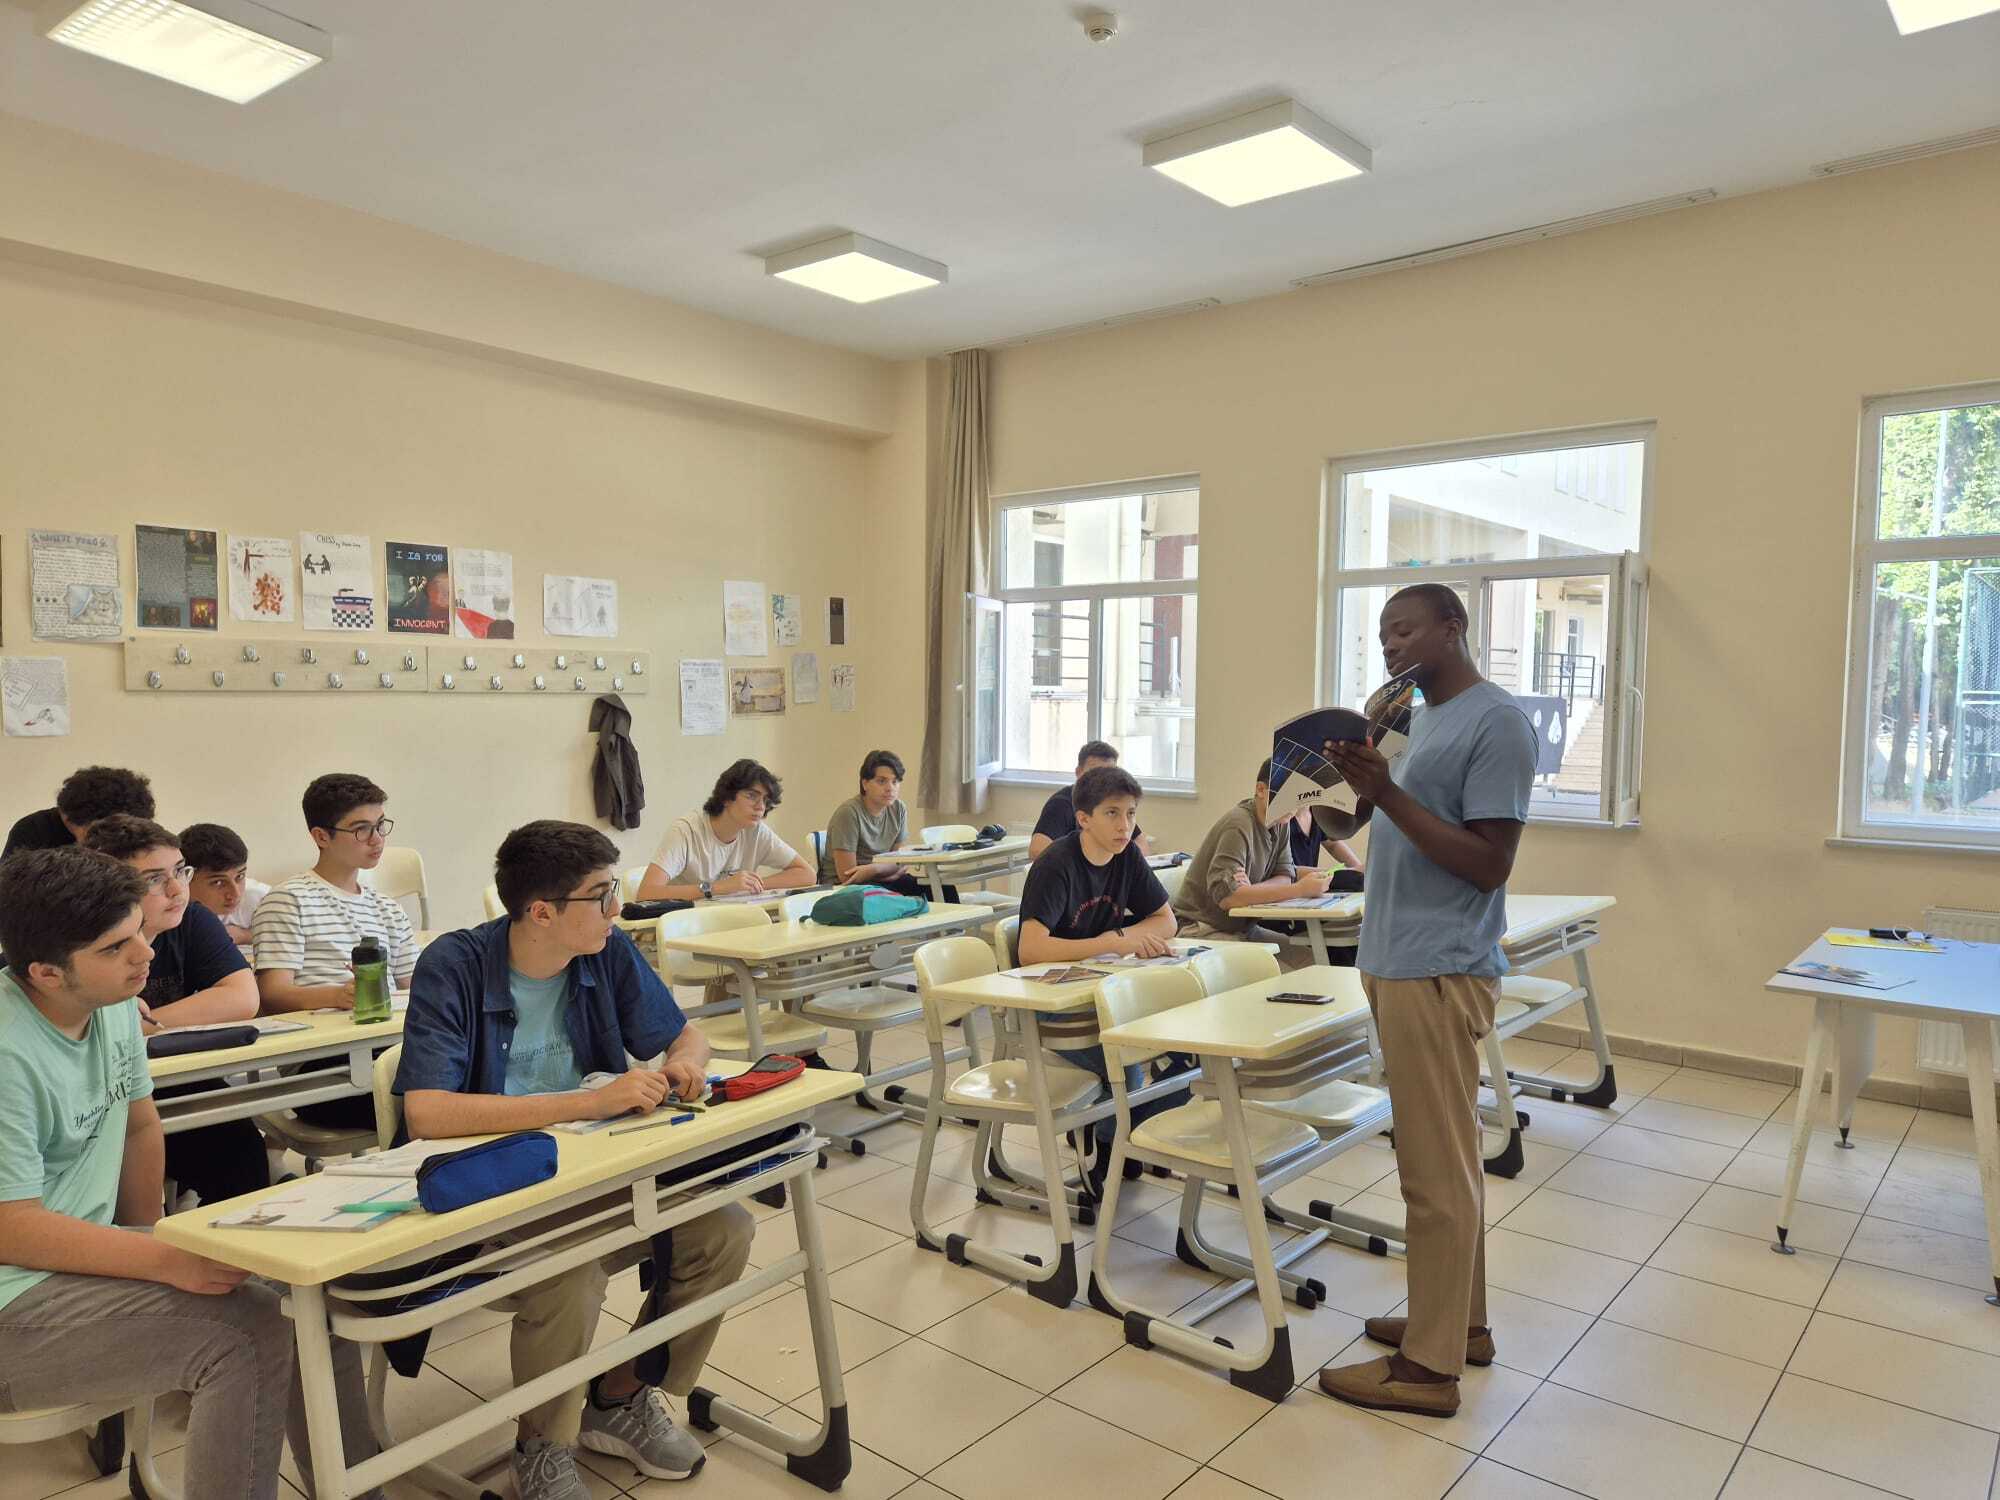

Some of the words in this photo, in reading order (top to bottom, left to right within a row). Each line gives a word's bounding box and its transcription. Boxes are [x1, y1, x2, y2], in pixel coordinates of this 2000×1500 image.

[395, 550, 403, 559] I
[408, 551, 421, 560] IS
[393, 618, 447, 629] INNOCENT
[1297, 789, 1322, 801] TIME
